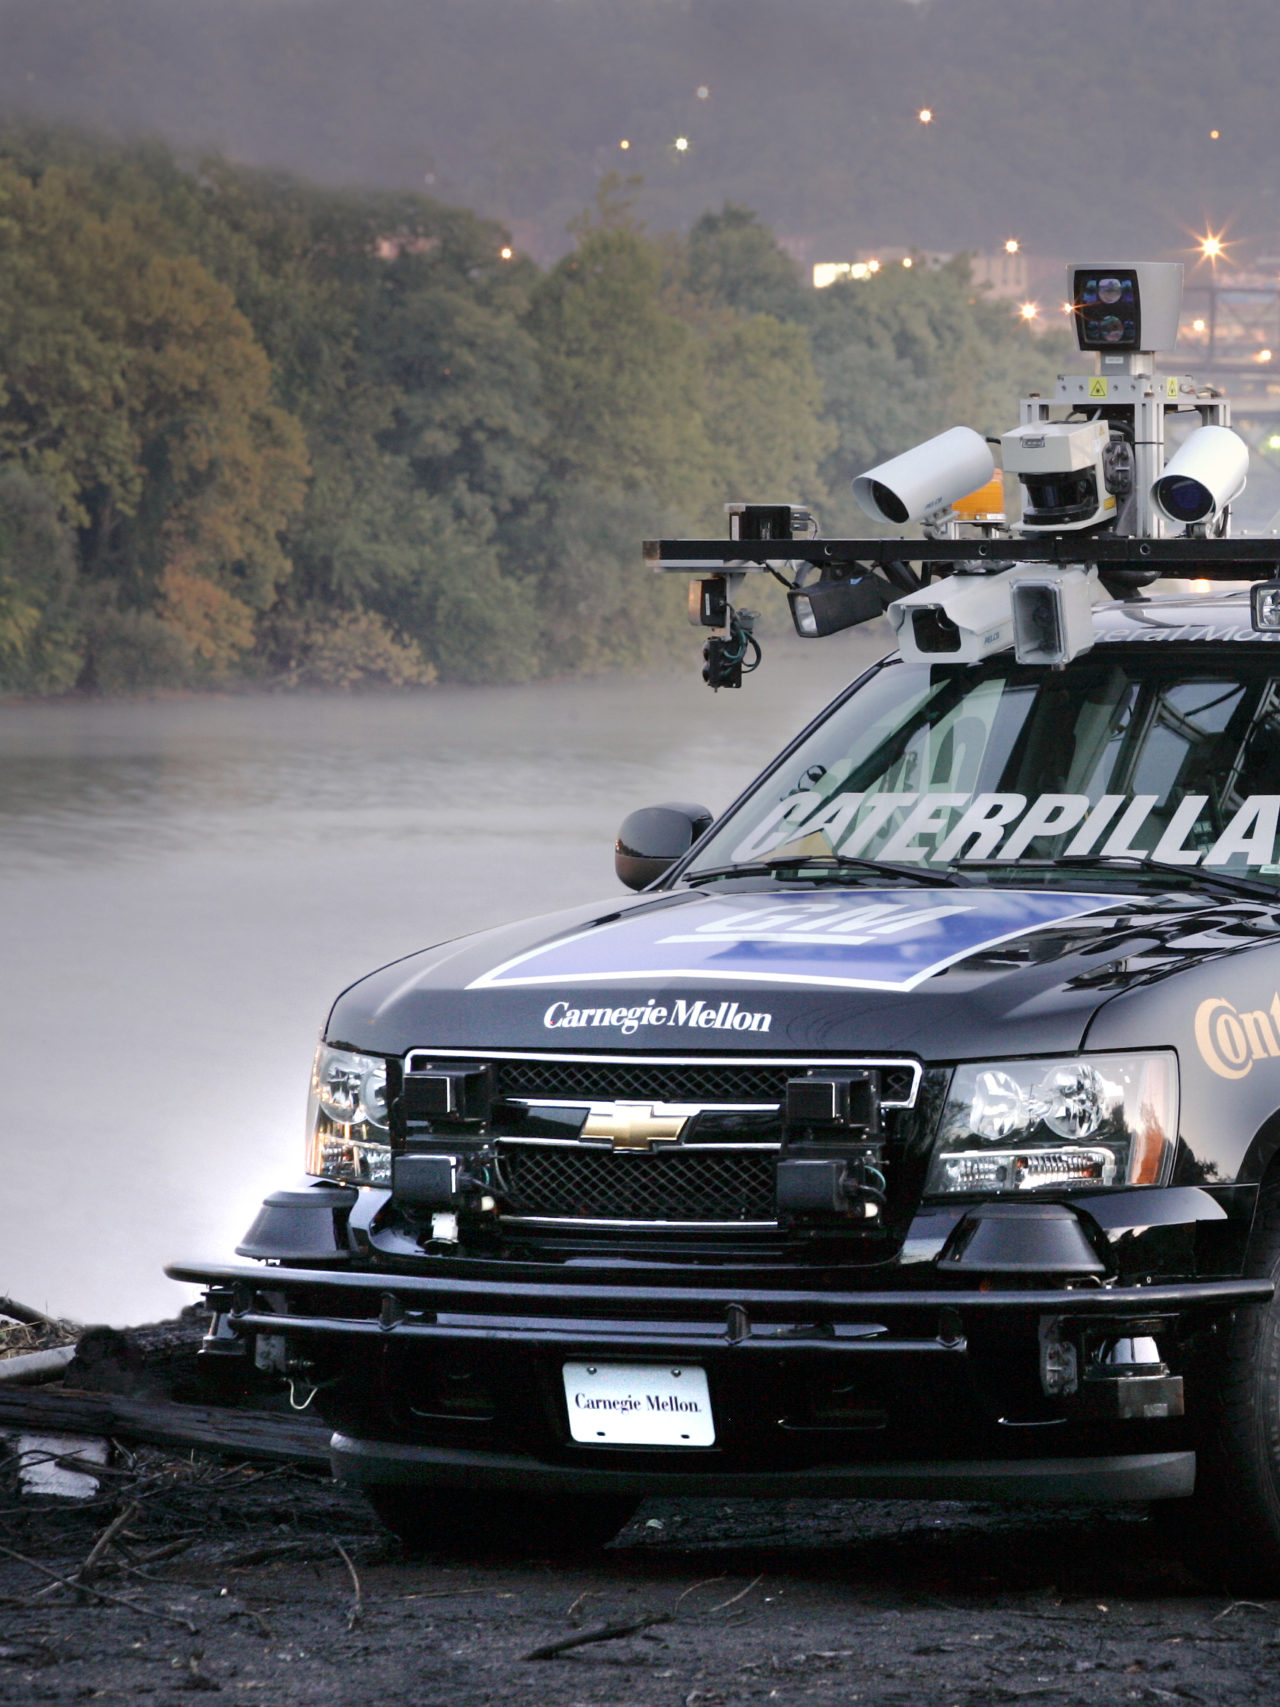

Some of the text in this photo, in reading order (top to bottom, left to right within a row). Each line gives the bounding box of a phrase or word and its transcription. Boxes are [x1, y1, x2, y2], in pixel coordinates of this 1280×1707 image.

[695, 903, 977, 934] GM
[543, 999, 772, 1035] Carnegie Mellon
[575, 1392, 642, 1416] Carnegie
